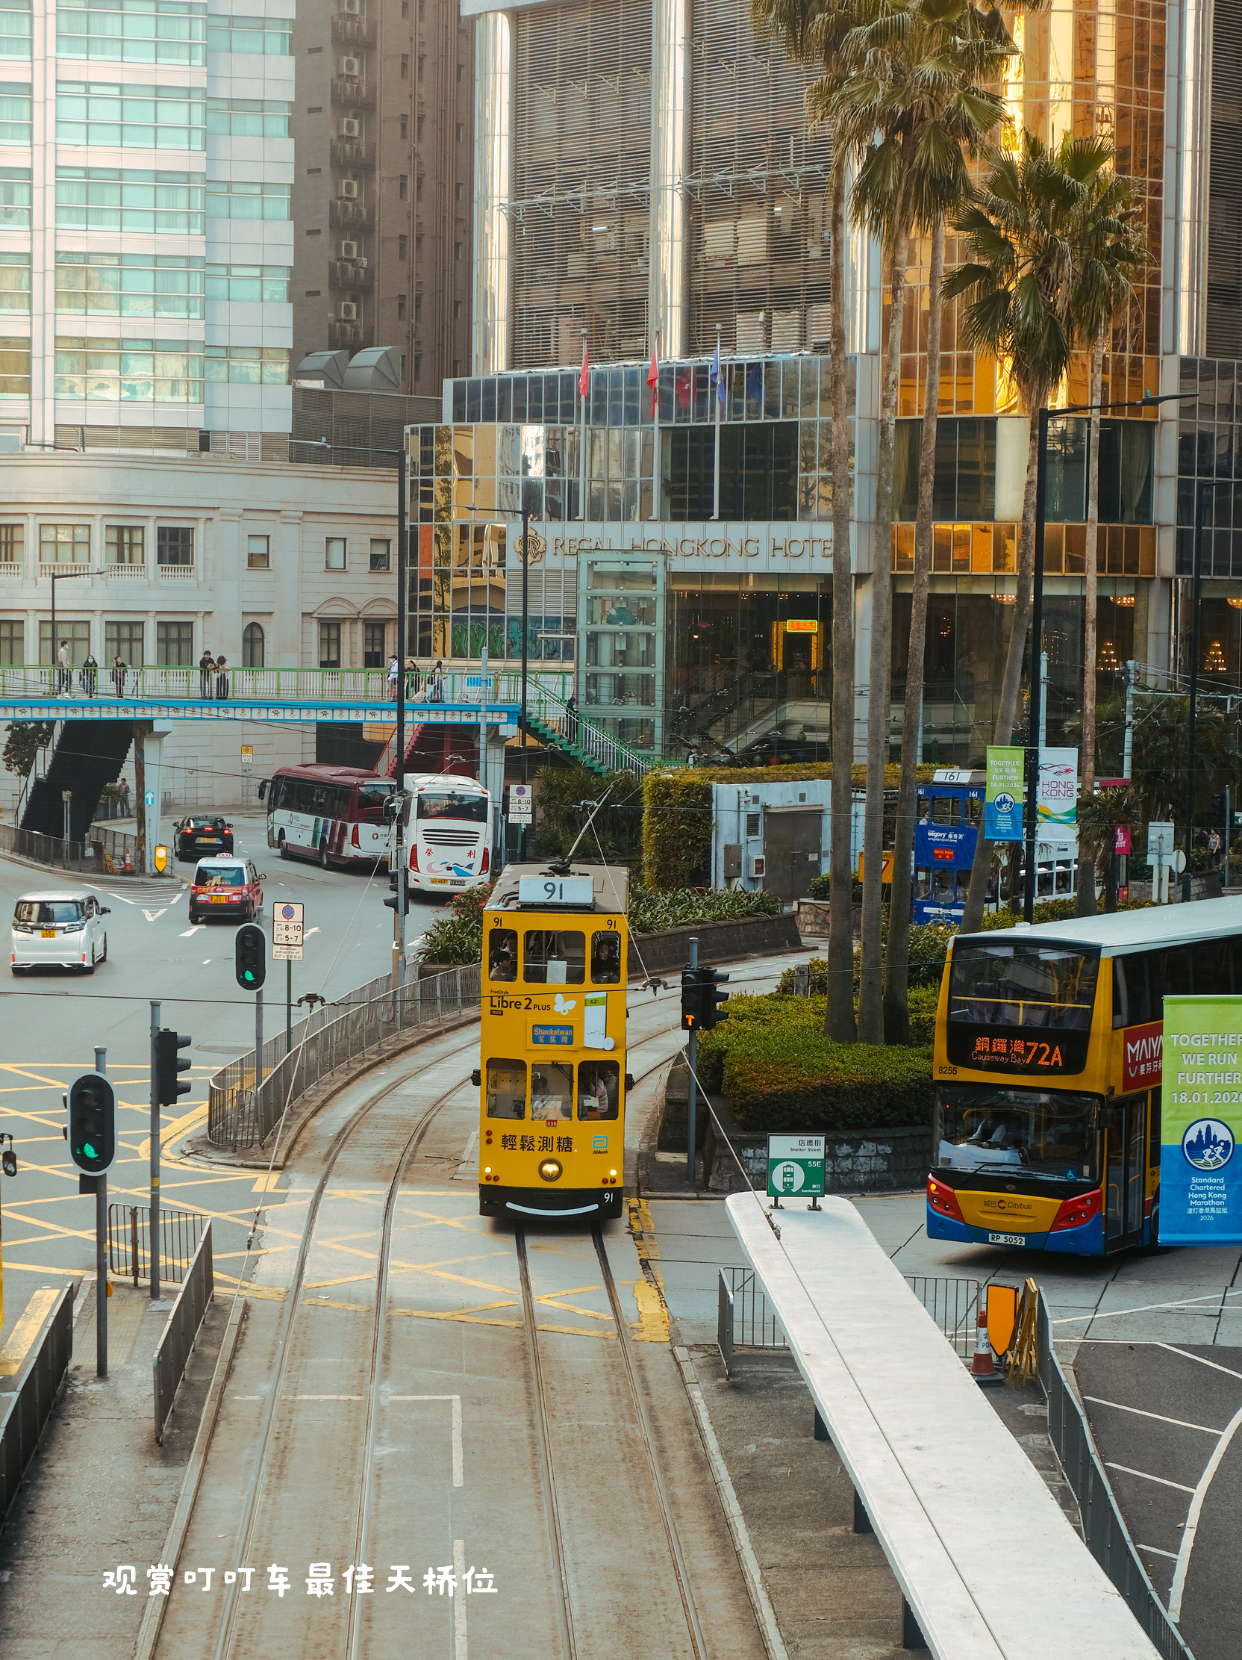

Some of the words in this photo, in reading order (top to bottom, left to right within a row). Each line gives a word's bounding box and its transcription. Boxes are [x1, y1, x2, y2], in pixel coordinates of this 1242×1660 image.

[552, 537, 612, 556] REGAL
[630, 537, 760, 557] HONGKONG
[770, 537, 834, 557] HOTE
[944, 772, 960, 781] 161
[1042, 780, 1074, 789] HONG
[1042, 789, 1074, 797] KONG
[543, 881, 563, 900] 91
[493, 917, 502, 927] 91
[606, 919, 617, 930] 91
[284, 924, 302, 932] 8-10
[490, 995, 522, 1009] Libre
[523, 997, 532, 1010] 2
[975, 1036, 1025, 1055] 銅鑼灣
[971, 1050, 1009, 1064] Causeway
[1010, 1053, 1026, 1065] Bay
[1026, 1041, 1063, 1067] 72A
[1182, 1052, 1205, 1066] WE
[1208, 1052, 1237, 1066] RUN
[938, 1066, 958, 1075] 8255
[1177, 1072, 1242, 1084] FURTHER
[501, 1133, 573, 1153] 輕鬆測糖
[603, 1192, 614, 1203] 91
[1188, 1192, 1207, 1200] Hong
[1208, 1191, 1227, 1200] Kong
[1007, 1201, 1032, 1210] Citybus
[990, 1234, 1001, 1242] RP
[1003, 1236, 1023, 1245] 5052
